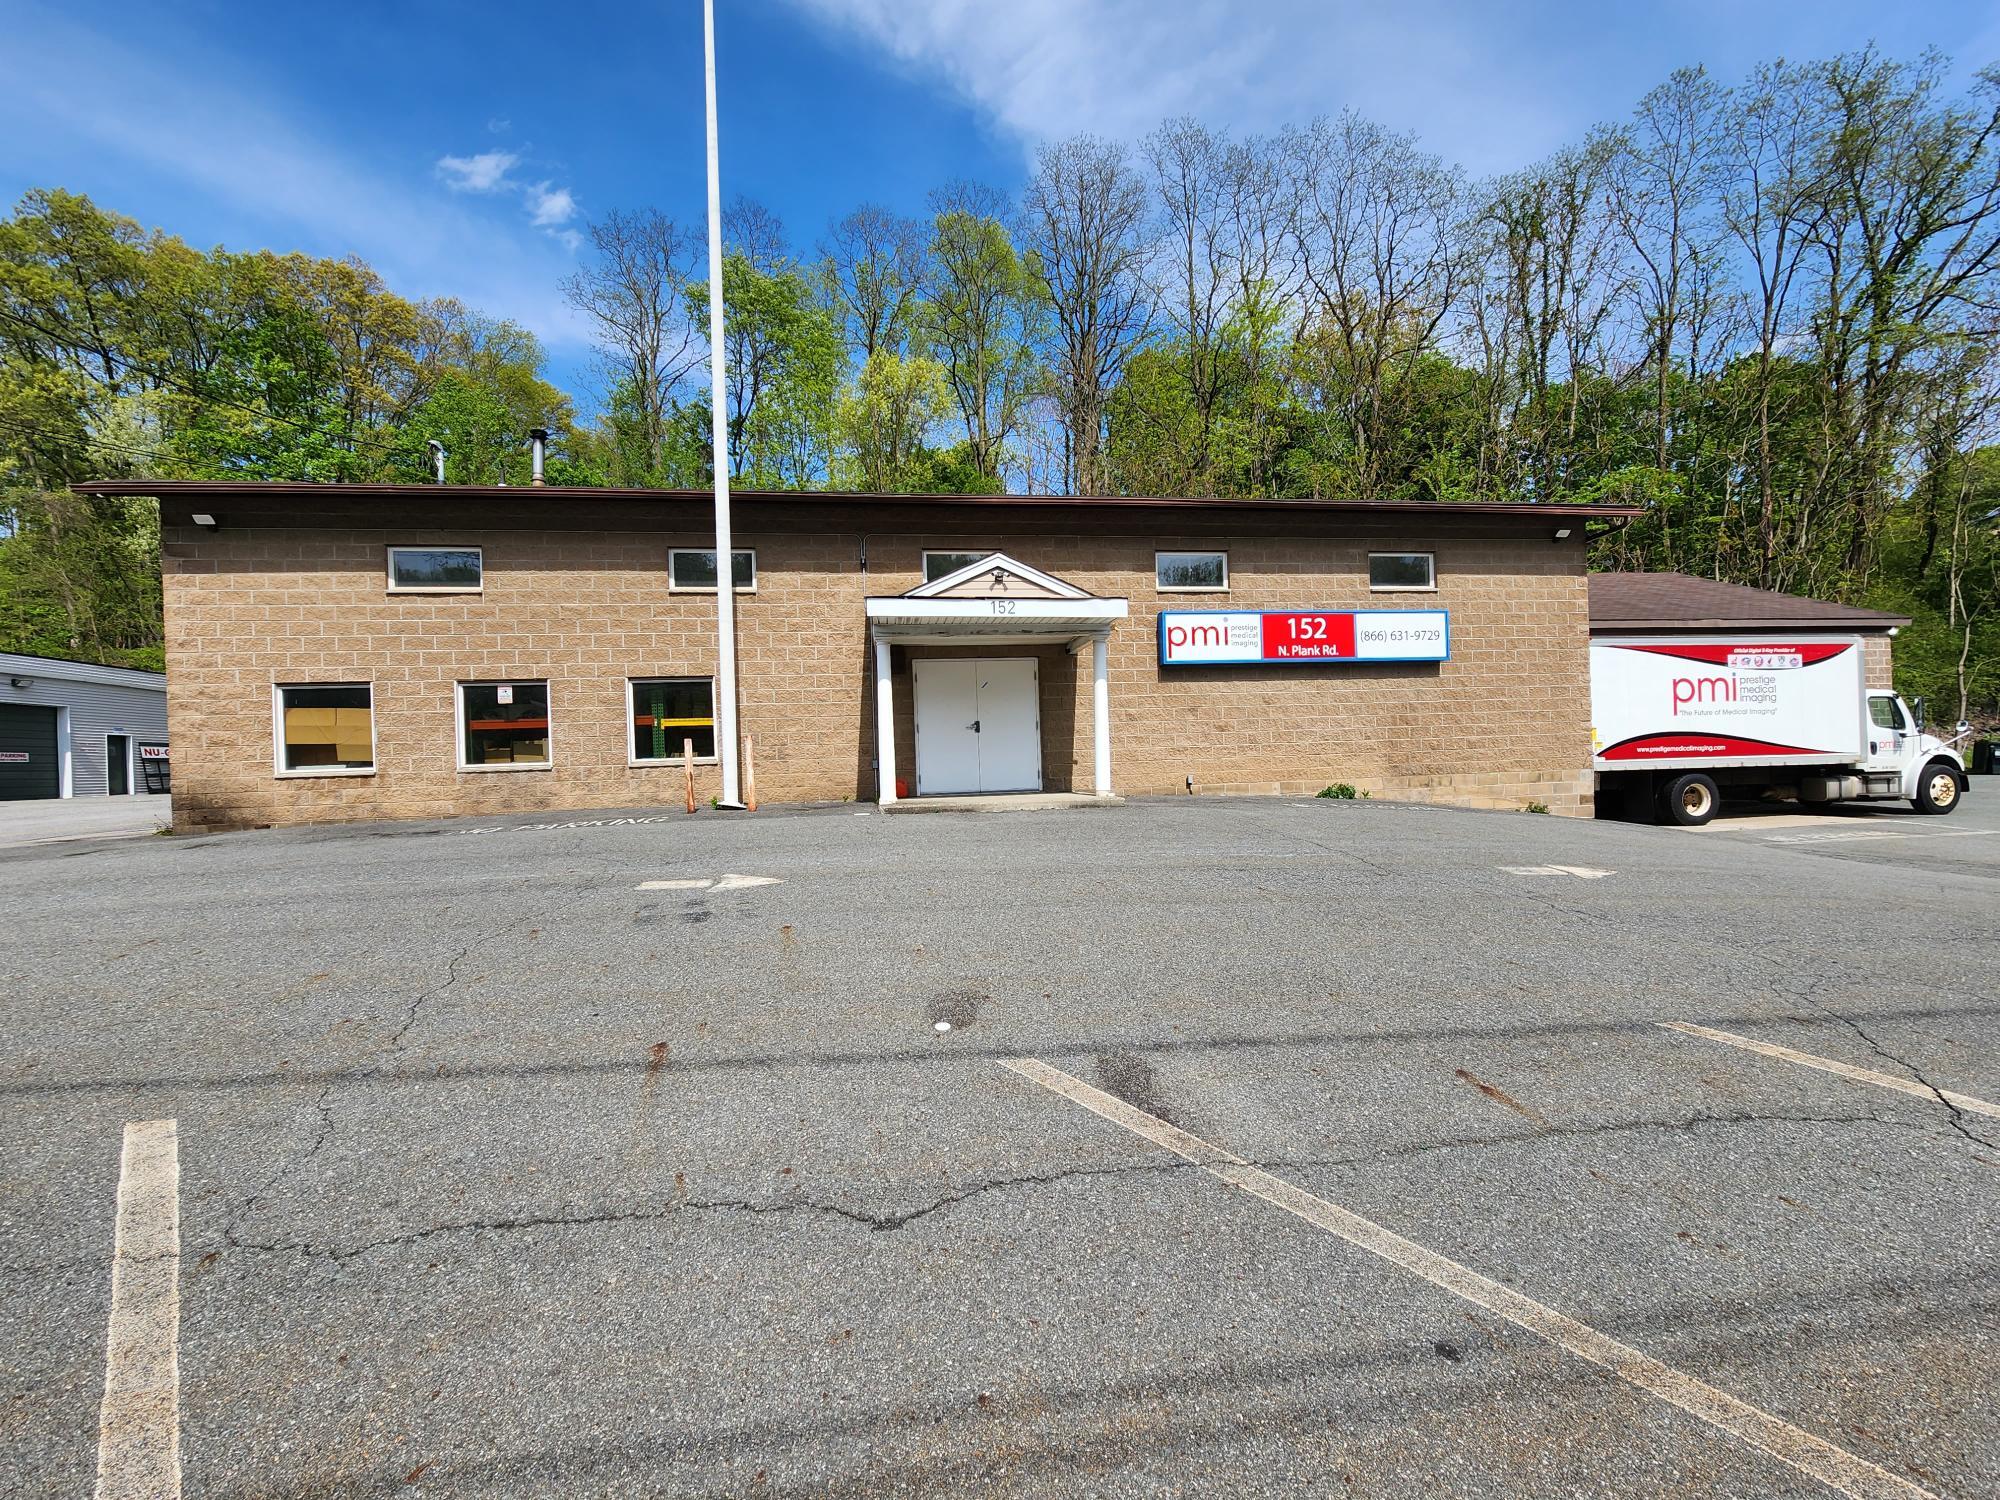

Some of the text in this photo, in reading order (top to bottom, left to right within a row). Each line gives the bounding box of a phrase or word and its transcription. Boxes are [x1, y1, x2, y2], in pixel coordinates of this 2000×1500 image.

[991, 600, 1015, 614] 152
[1231, 624, 1258, 632] prestige
[1287, 617, 1327, 639] 152
[1167, 617, 1229, 659] pmi
[1360, 630, 1440, 643] (866) 631-9729
[1231, 639, 1259, 648] imaging
[1278, 644, 1340, 656] N. Plank Rd.
[1739, 676, 1776, 685] prestige
[1672, 672, 1737, 716] pmi
[1739, 685, 1777, 694] medical
[1739, 694, 1777, 704] imaging
[1722, 708, 1748, 716] Medical
[512, 816, 669, 832] PARKING
